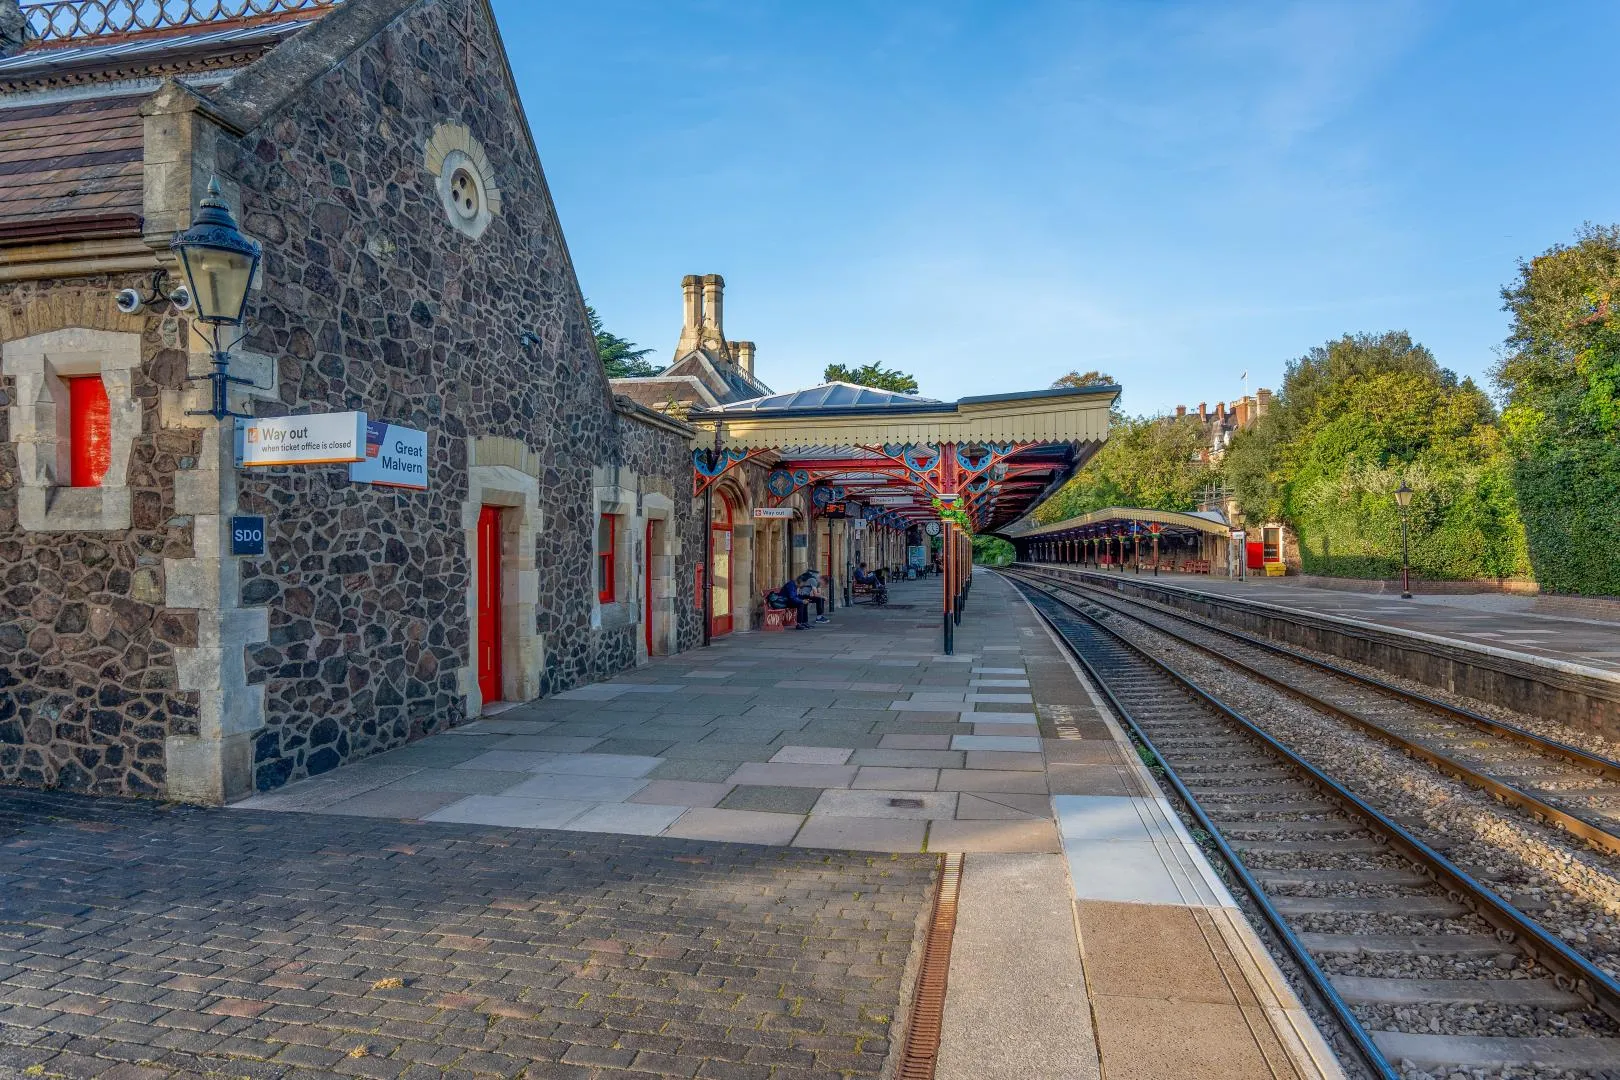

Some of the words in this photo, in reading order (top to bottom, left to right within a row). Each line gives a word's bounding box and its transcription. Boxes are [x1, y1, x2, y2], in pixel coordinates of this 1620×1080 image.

[262, 428, 287, 443] Way
[289, 427, 308, 439] out
[261, 443, 280, 452] when
[281, 443, 300, 452] ticket
[301, 441, 320, 450] office
[322, 441, 328, 449] is
[328, 440, 352, 449] closed
[395, 440, 422, 457] Great
[382, 455, 422, 473] Malvern
[234, 529, 262, 541] SDO
